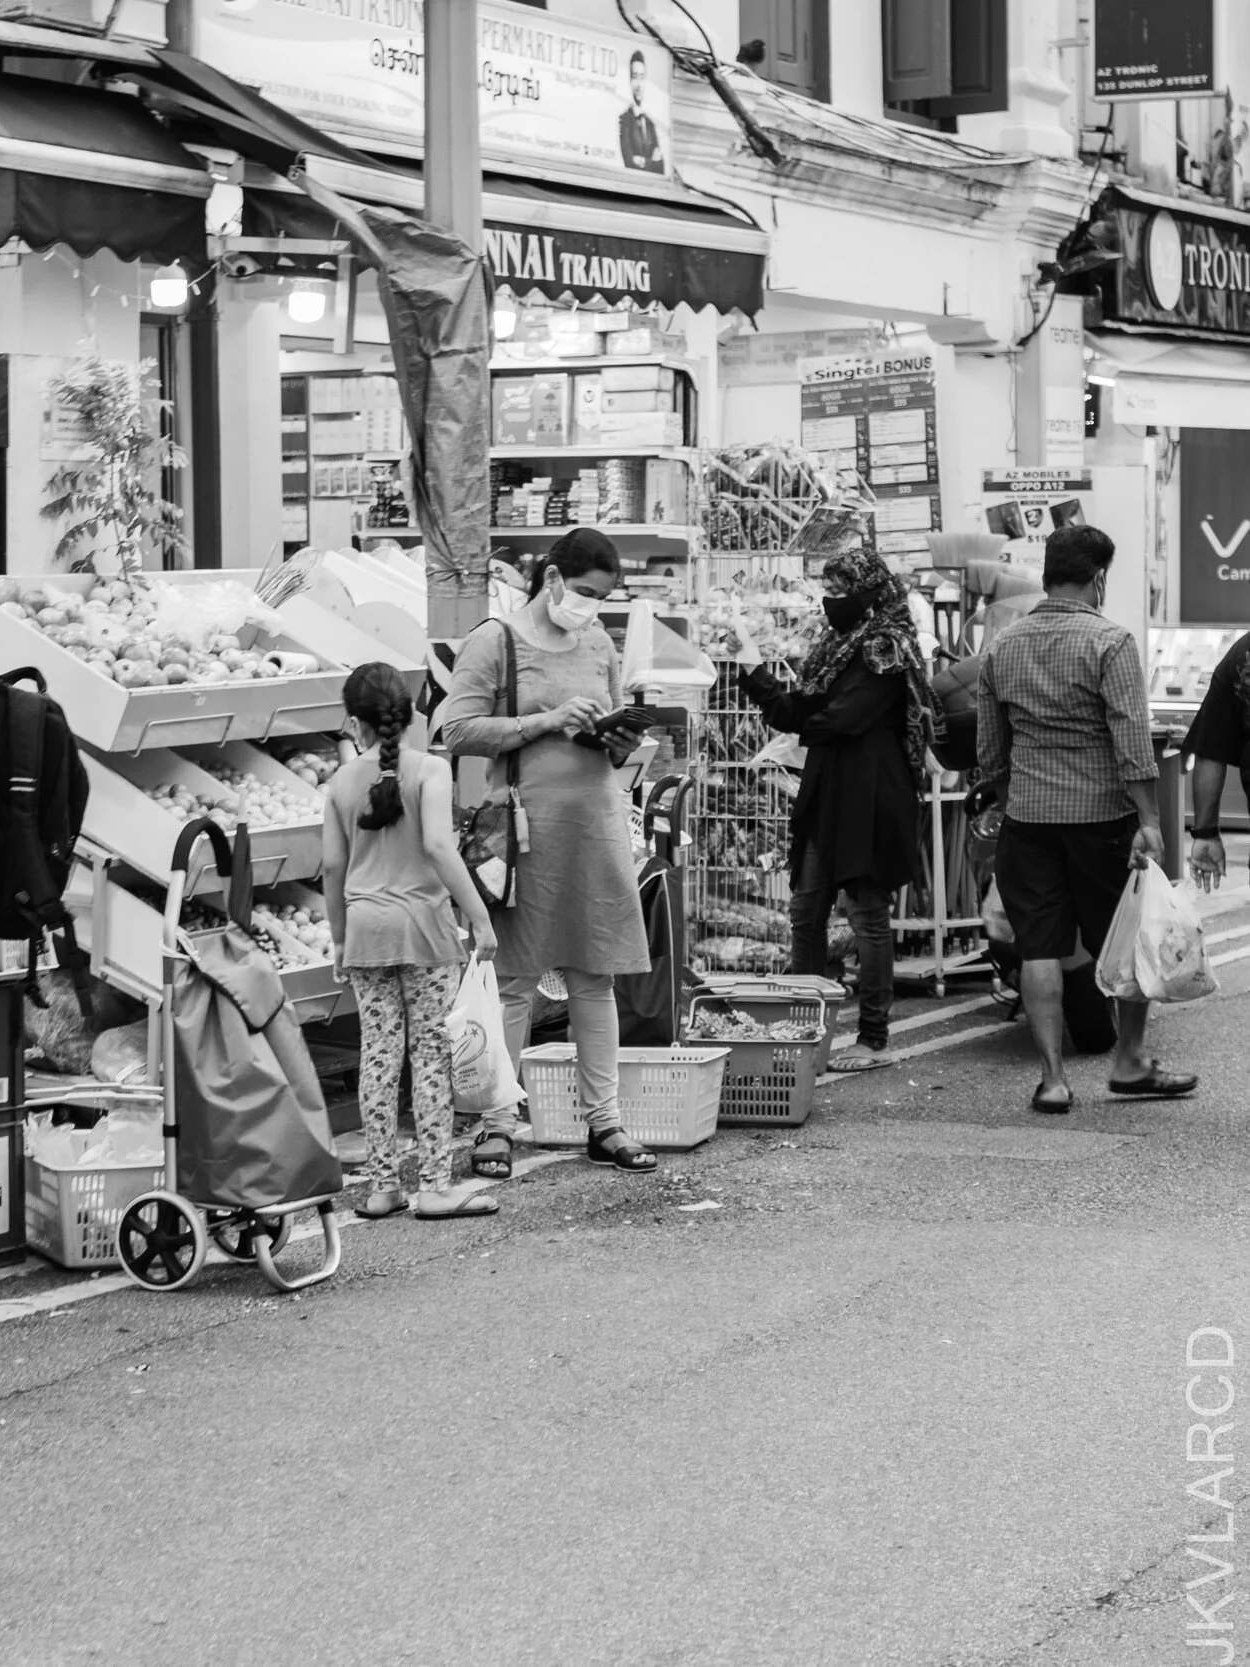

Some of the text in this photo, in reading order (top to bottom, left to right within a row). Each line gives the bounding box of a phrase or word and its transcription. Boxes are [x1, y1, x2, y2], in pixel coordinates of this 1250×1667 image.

[560, 37, 586, 71] PTE
[591, 45, 618, 78] LTD
[1097, 64, 1159, 77] AZ TRONIC
[1118, 78, 1164, 90] DUNLOP
[1166, 74, 1209, 86] STREET
[483, 228, 651, 292] NNAI TRADING
[1185, 243, 1250, 293] TRONI
[814, 356, 932, 381] Singtel BONUS
[1005, 471, 1071, 480] AZ MOBILES
[1010, 481, 1065, 491] OPPO A12
